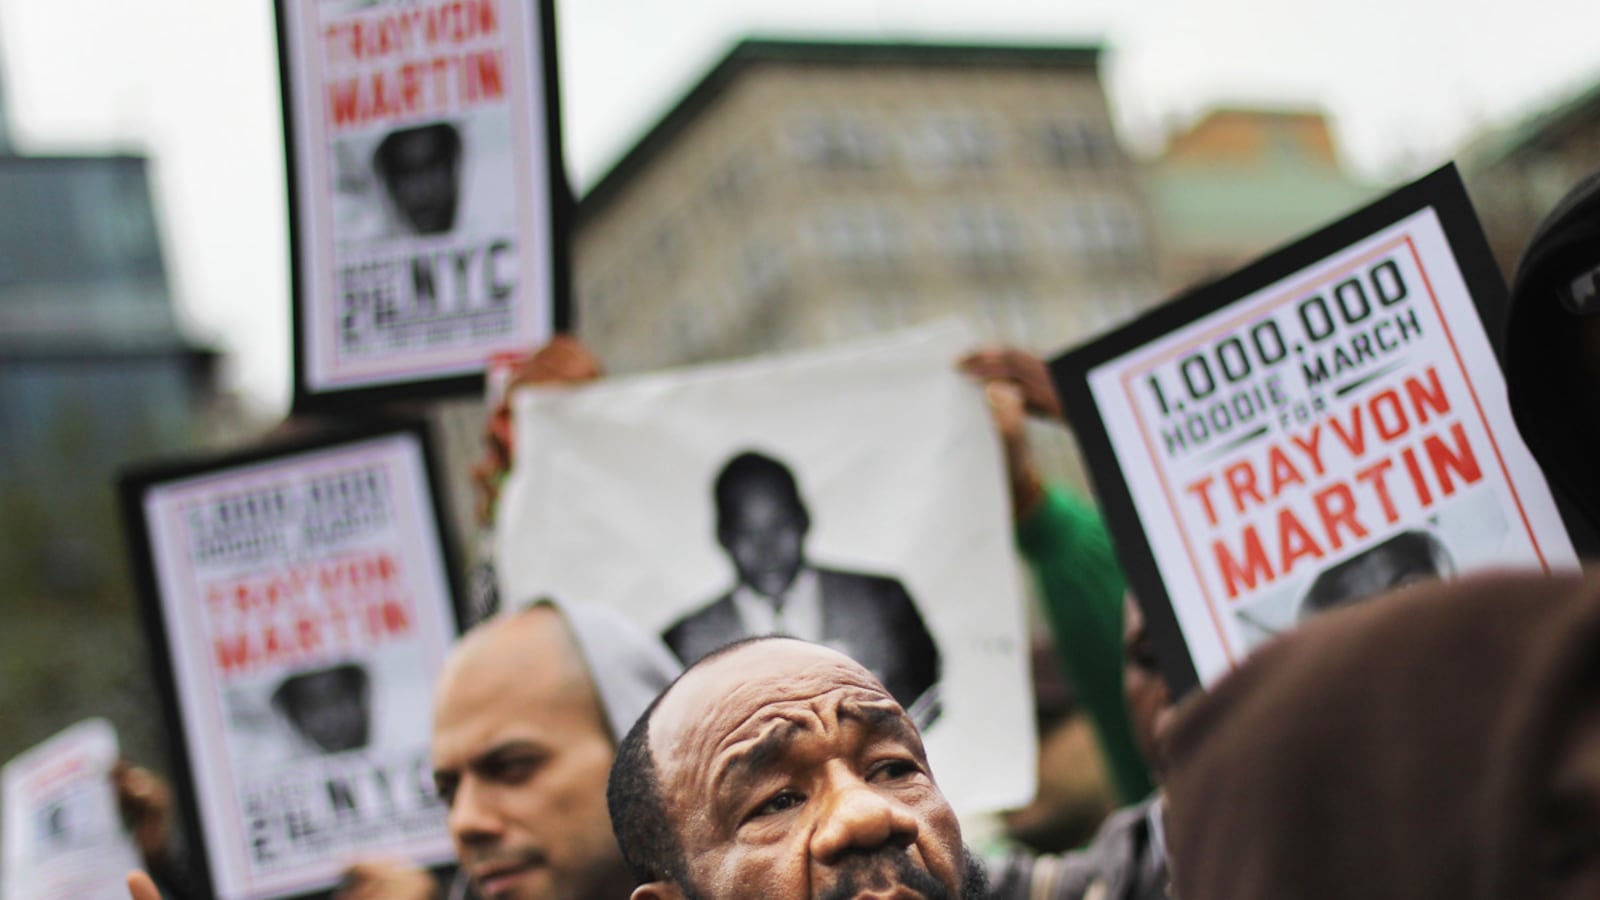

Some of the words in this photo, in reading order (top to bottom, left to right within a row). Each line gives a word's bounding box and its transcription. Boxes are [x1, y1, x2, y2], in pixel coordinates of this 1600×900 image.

[408, 241, 514, 309] NYC
[1161, 374, 1288, 456] HOODIE
[1302, 309, 1423, 388] MARCH
[1185, 366, 1453, 527] TRAYVON
[1279, 396, 1327, 429] FOR
[1210, 421, 1484, 600] MARTIN
